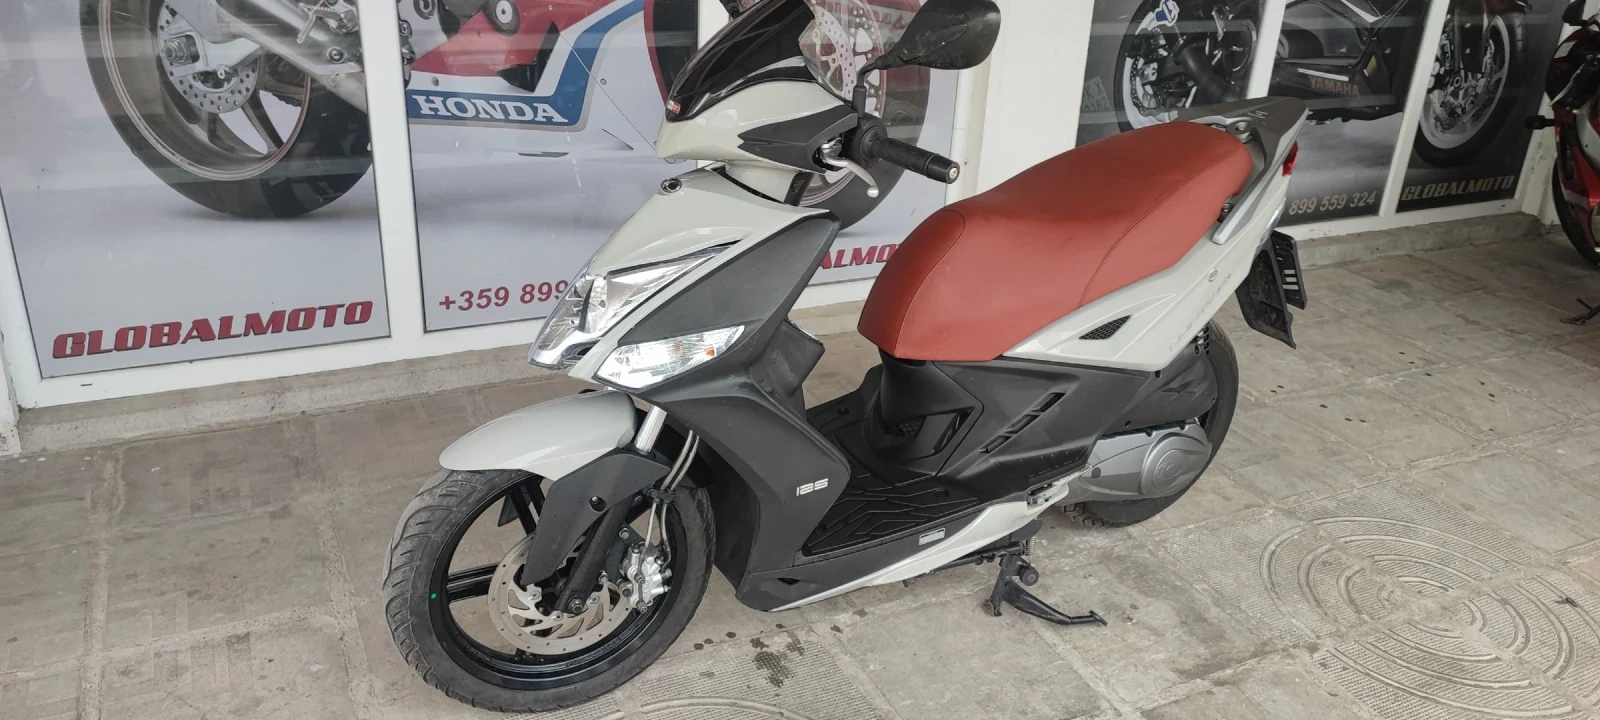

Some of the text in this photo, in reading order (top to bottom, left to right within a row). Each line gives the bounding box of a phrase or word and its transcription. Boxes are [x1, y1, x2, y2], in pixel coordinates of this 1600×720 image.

[1308, 75, 1360, 98] YAMAHA
[411, 95, 569, 123] HONDA
[1401, 175, 1515, 201] GLOBALMOTO
[1288, 190, 1378, 215] 899 559 324
[439, 279, 569, 311] +359 899
[52, 300, 373, 359] GLOBALMOTO
[795, 477, 829, 497] 125
